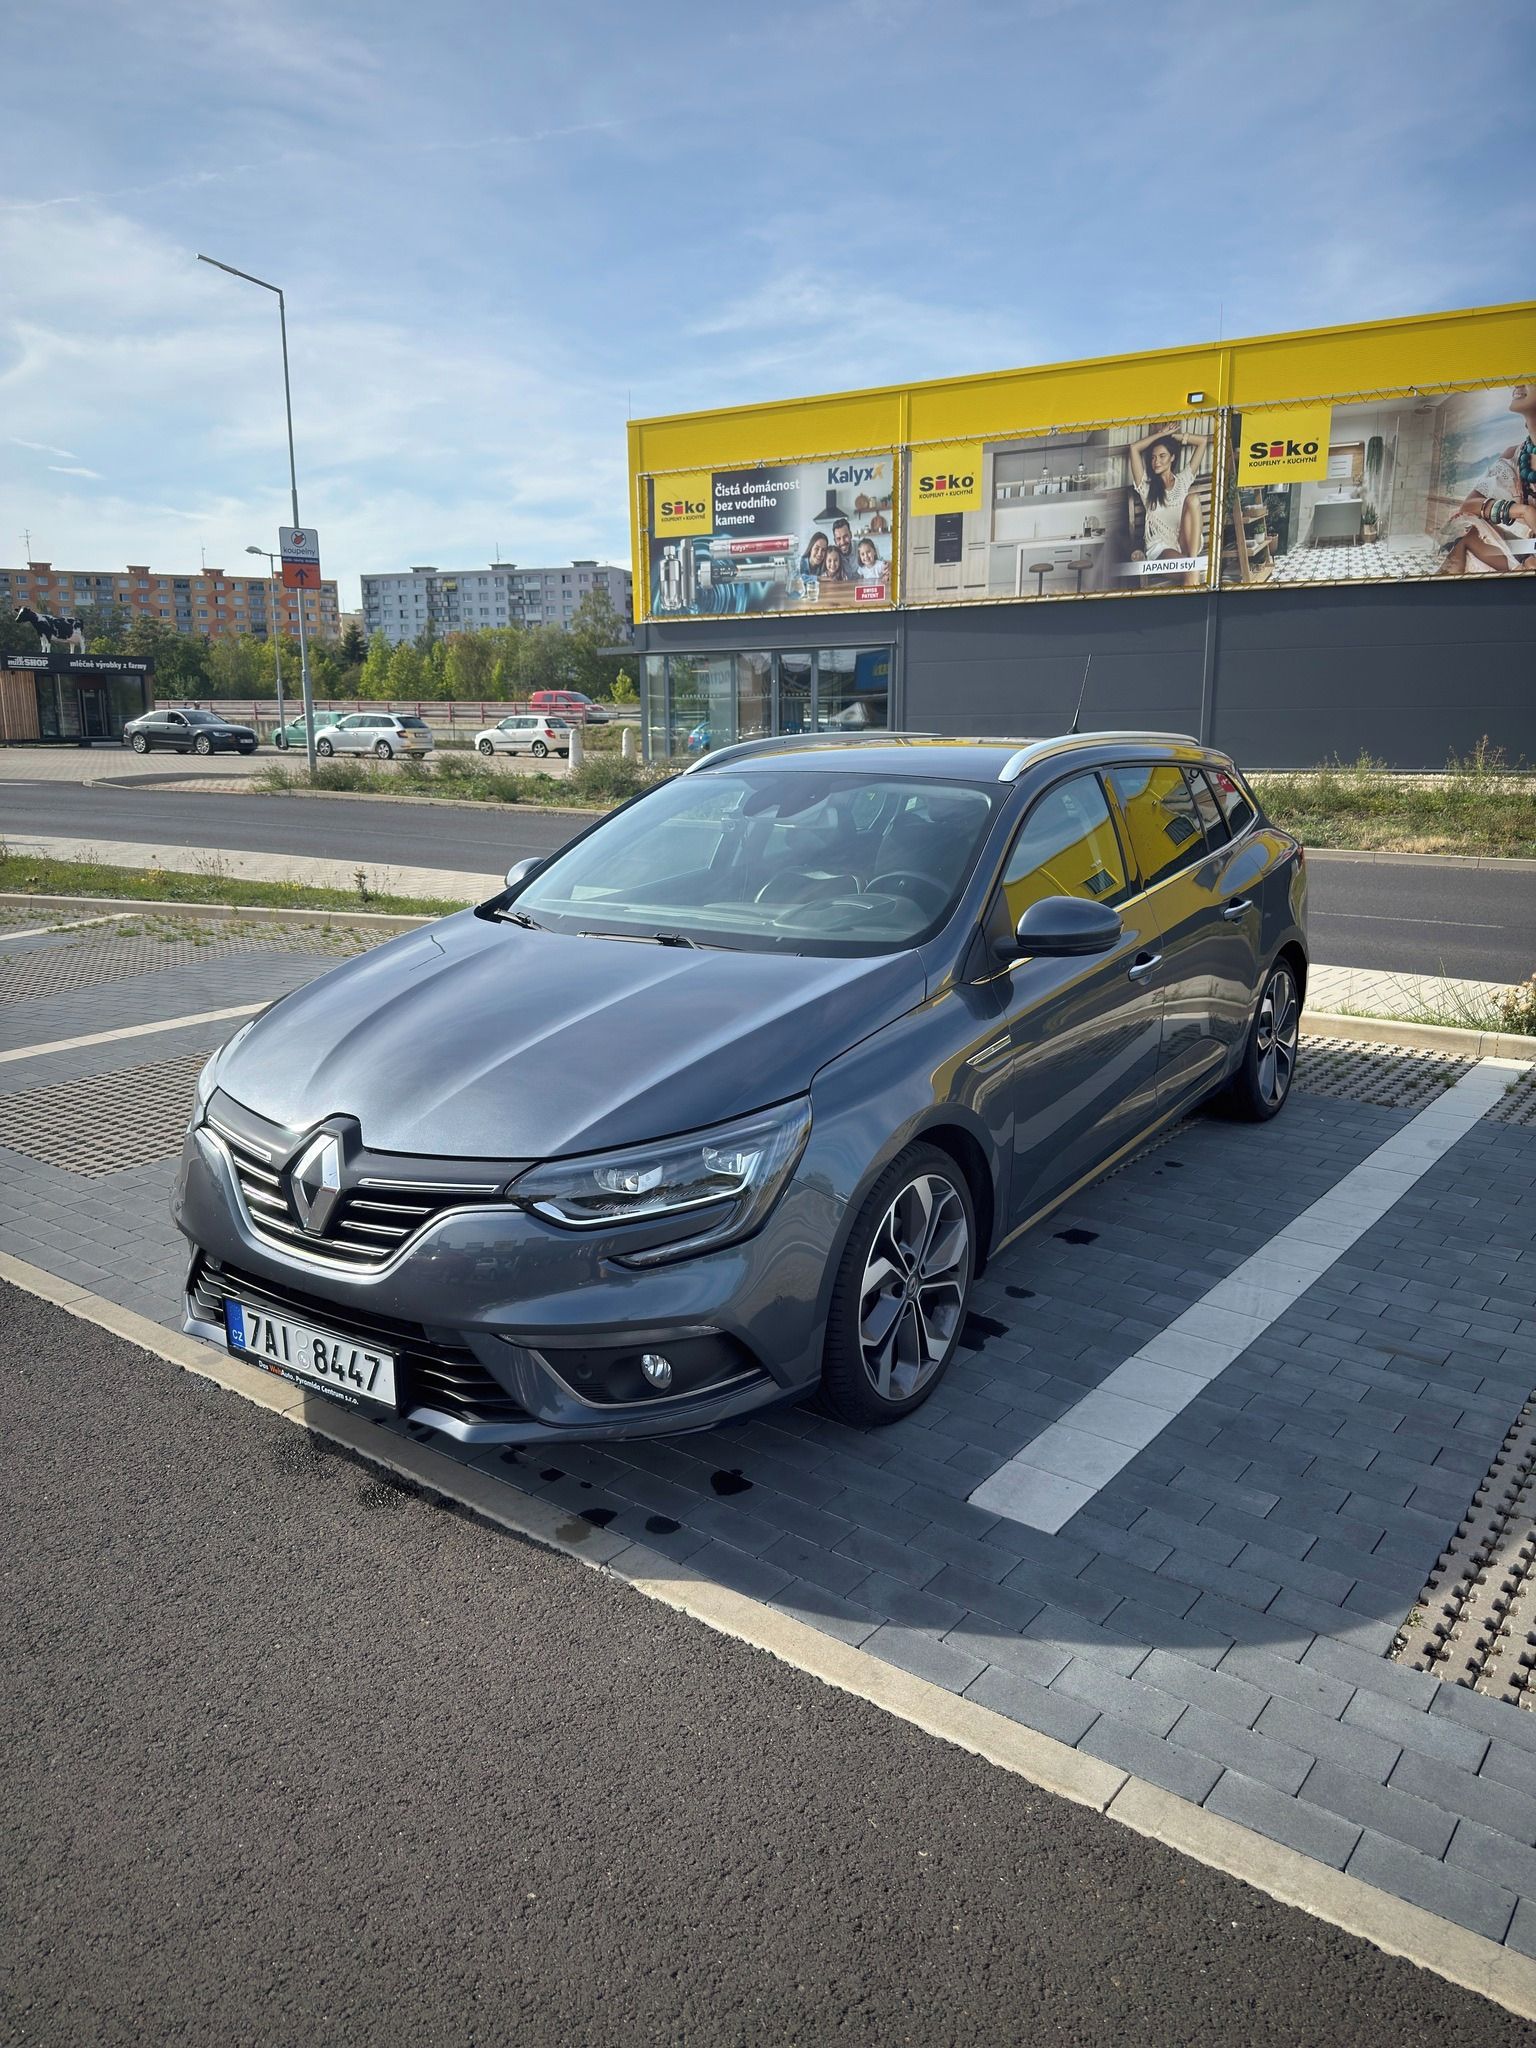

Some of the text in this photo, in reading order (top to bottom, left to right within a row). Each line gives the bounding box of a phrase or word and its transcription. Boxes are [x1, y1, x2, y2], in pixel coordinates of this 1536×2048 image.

[715, 479, 800, 497] Čistá domácnost
[715, 495, 777, 512] bez vodního
[715, 514, 755, 526] kamene
[1142, 560, 1196, 573] JAPANDI styl
[95, 660, 122, 670] výrobky
[128, 661, 147, 671] farmy
[232, 1329, 244, 1342] CZ
[247, 1311, 381, 1392] 7AI 8447
[258, 1360, 269, 1370] Das
[320, 1385, 345, 1400] Centrum
[344, 1395, 359, 1405] s.r.o.
